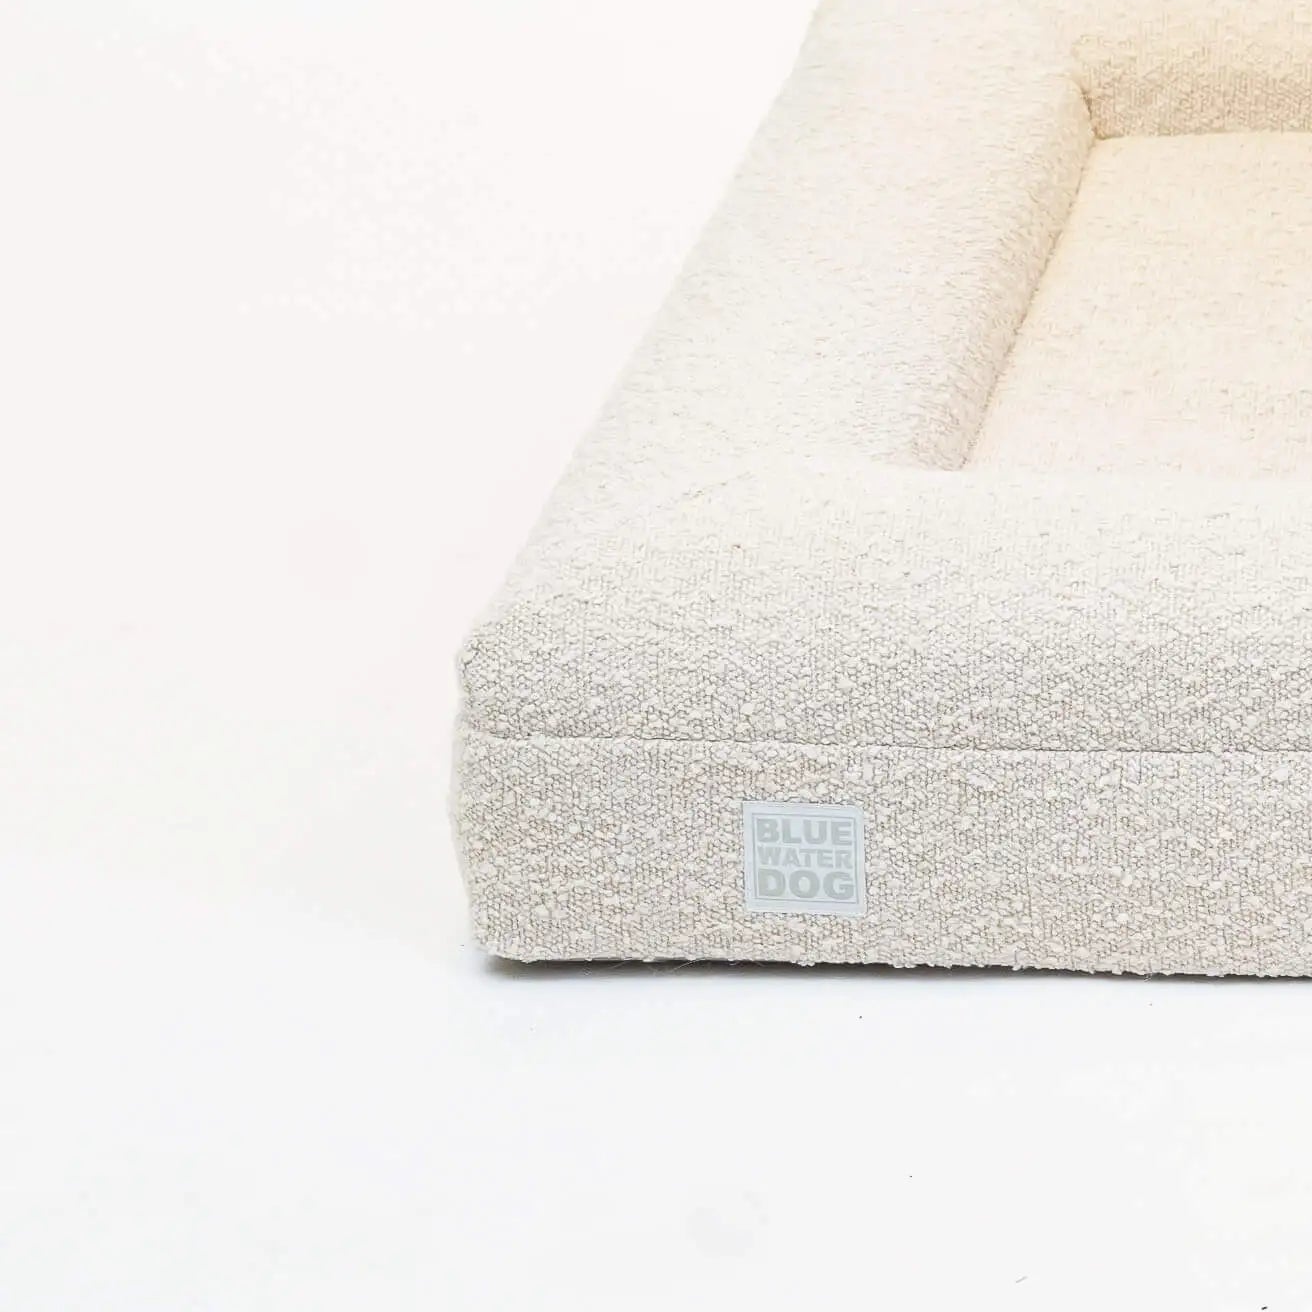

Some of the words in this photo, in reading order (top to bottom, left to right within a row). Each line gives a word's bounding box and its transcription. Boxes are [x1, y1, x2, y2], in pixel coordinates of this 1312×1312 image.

[757, 818, 852, 846] BLUE
[757, 846, 853, 869] WATER
[758, 869, 854, 900] DOG
